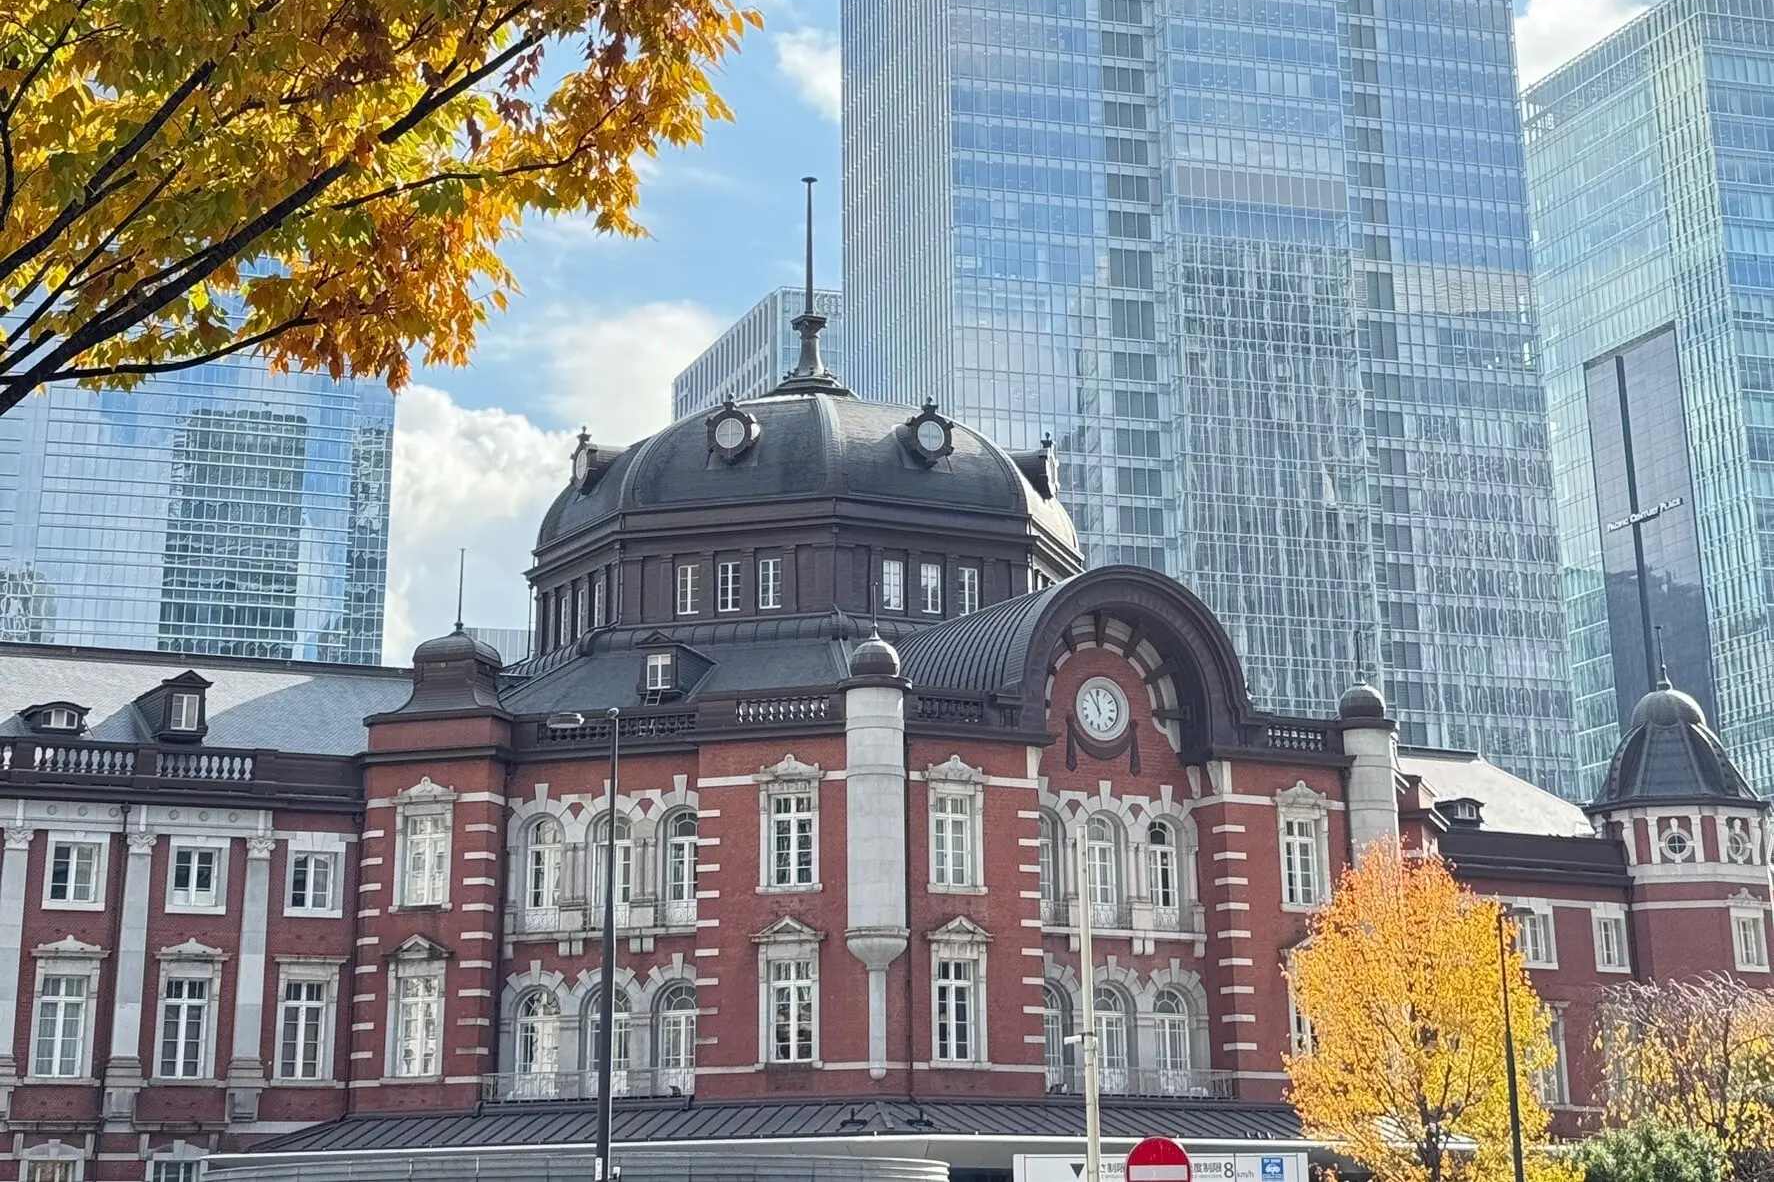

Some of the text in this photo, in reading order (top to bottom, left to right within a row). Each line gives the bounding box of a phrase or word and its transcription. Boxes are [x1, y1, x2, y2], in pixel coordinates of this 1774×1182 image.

[1629, 506, 1659, 523] CENTURY
[1223, 1161, 1234, 1178] 8
[1237, 1170, 1255, 1178] km/h
